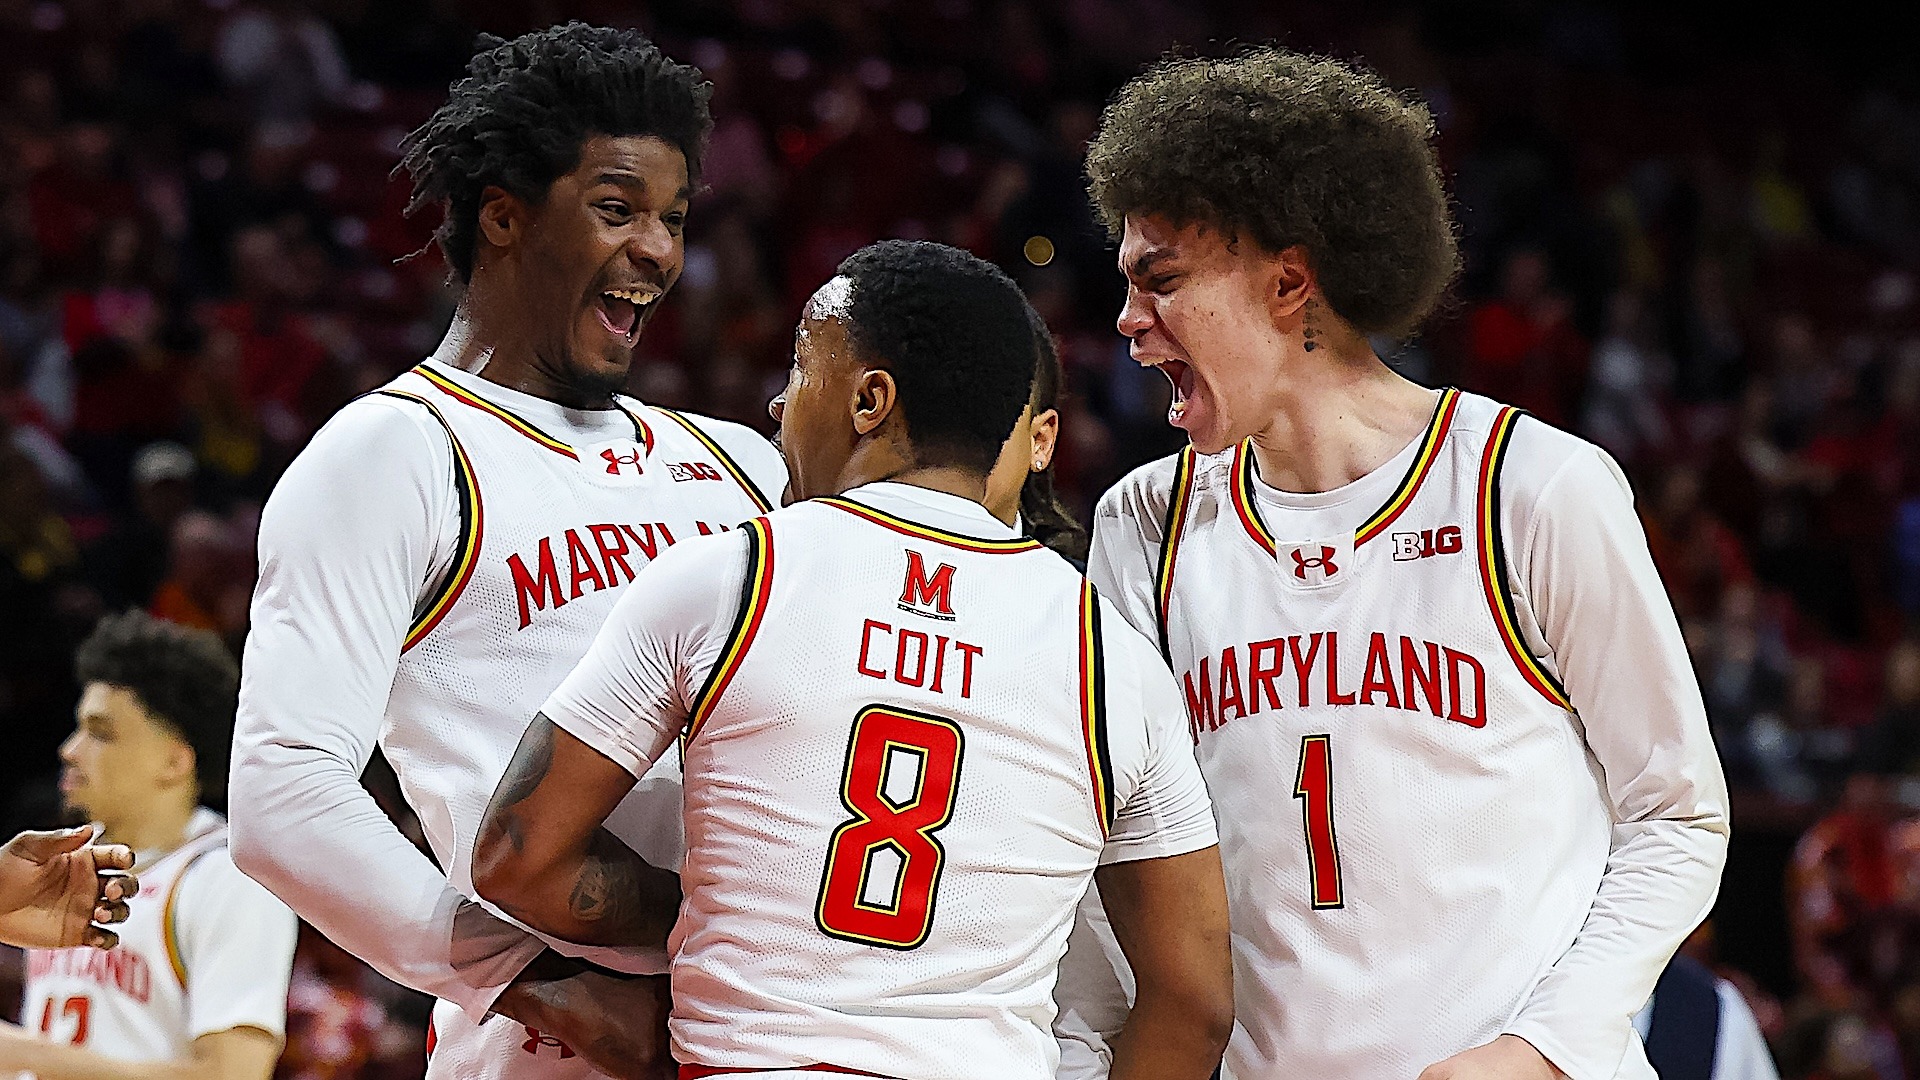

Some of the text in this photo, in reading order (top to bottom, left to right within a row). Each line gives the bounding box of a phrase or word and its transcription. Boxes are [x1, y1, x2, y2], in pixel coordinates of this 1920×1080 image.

[899, 548, 957, 612] M
[858, 618, 983, 699] COIT
[1183, 631, 1487, 747] MARYLAND
[814, 703, 966, 951] 8
[1293, 734, 1345, 911] 1
